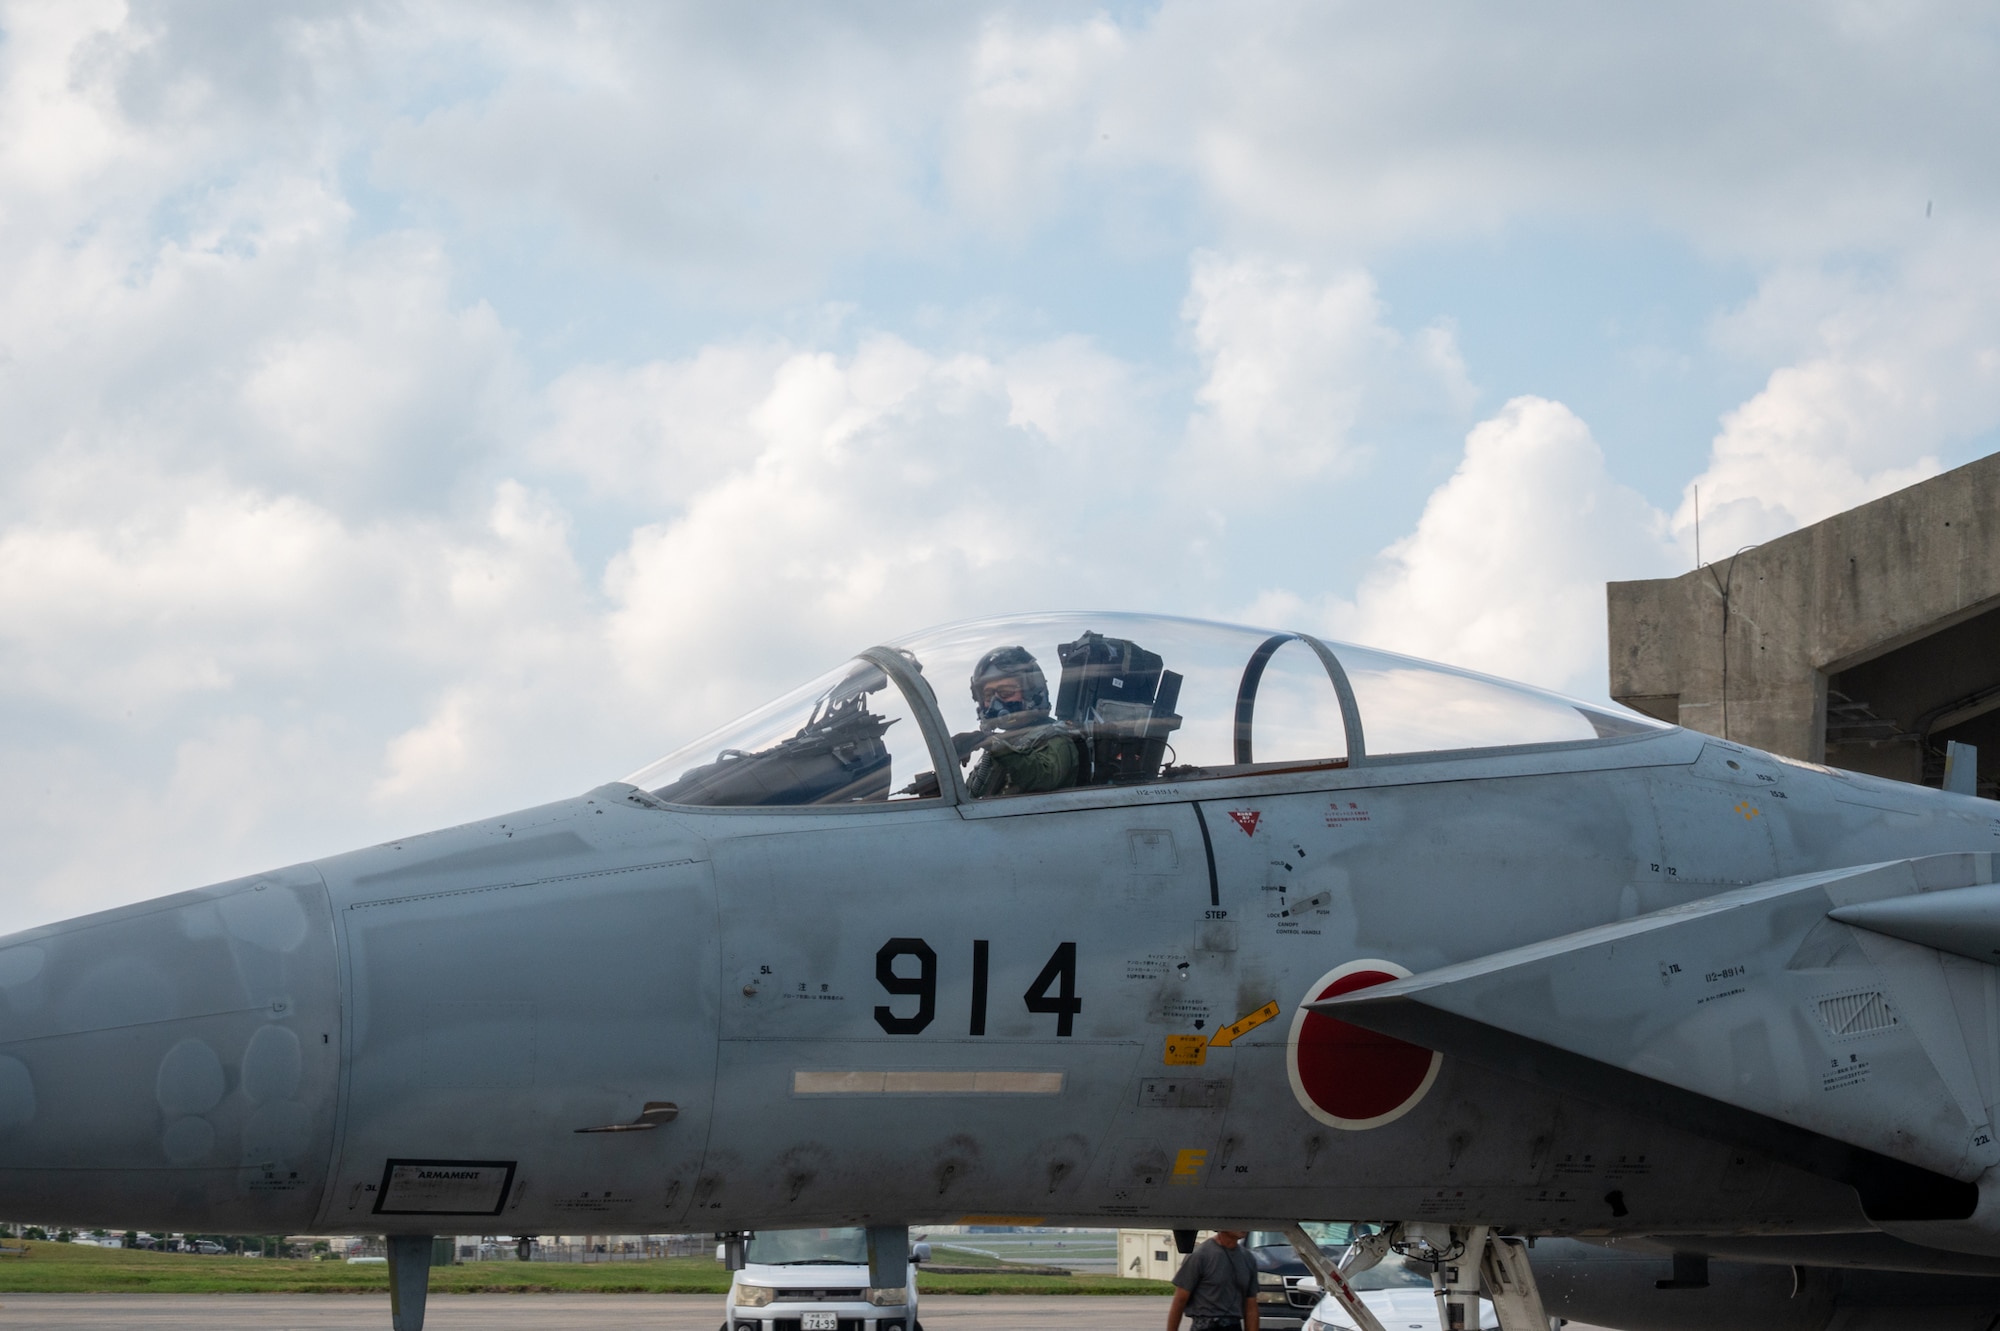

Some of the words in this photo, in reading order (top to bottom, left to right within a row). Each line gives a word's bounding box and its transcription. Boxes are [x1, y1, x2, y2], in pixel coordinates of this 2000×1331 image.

[1650, 863, 1660, 873] 12
[1667, 867, 1677, 876] 12
[1205, 910, 1227, 919] STEP
[760, 965, 772, 975] 5L
[1705, 965, 1745, 983] 02-8914
[798, 982, 829, 993] 注意
[874, 937, 1083, 1037] 914
[323, 1034, 329, 1044] 1
[1169, 1045, 1176, 1054] 9
[1974, 1134, 1991, 1147] 22L
[418, 1171, 480, 1180] ARMAMENT
[809, 1319, 835, 1329] 74-99
